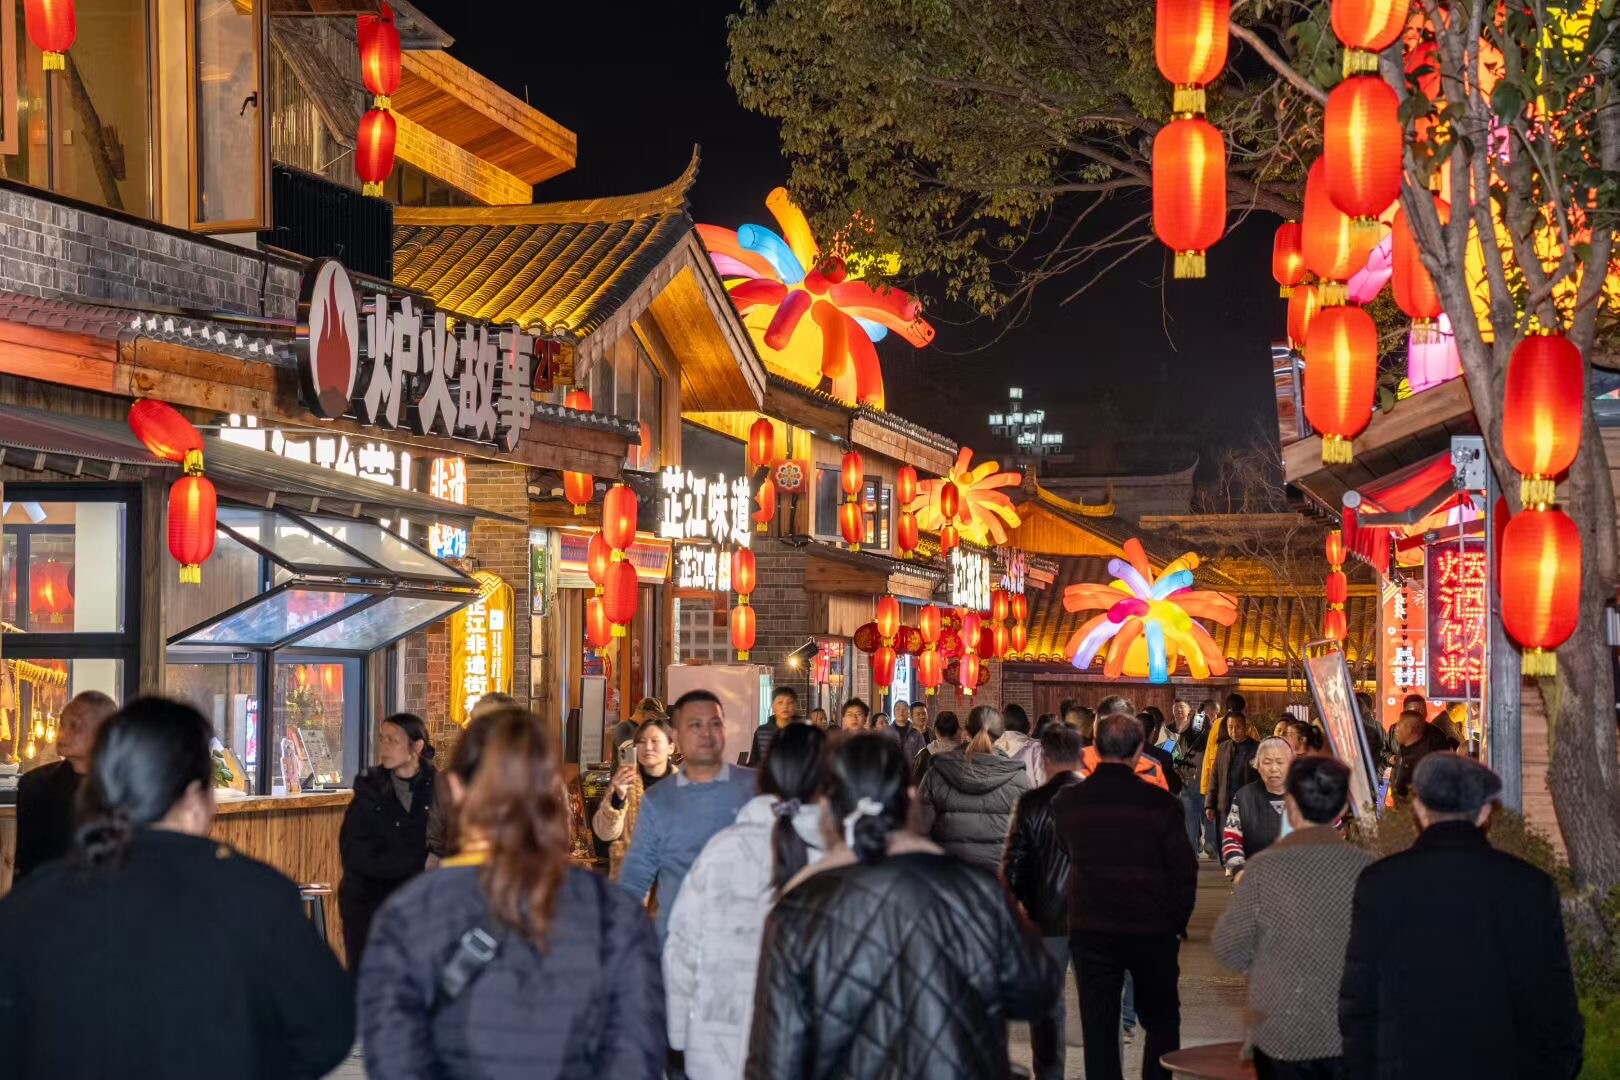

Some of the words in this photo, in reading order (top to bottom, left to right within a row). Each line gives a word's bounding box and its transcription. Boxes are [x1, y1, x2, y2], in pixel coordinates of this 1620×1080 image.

[364, 294, 534, 452] 炉火故事
[661, 464, 751, 549] 芷江味道
[1439, 550, 1487, 690] 烟酒饮料
